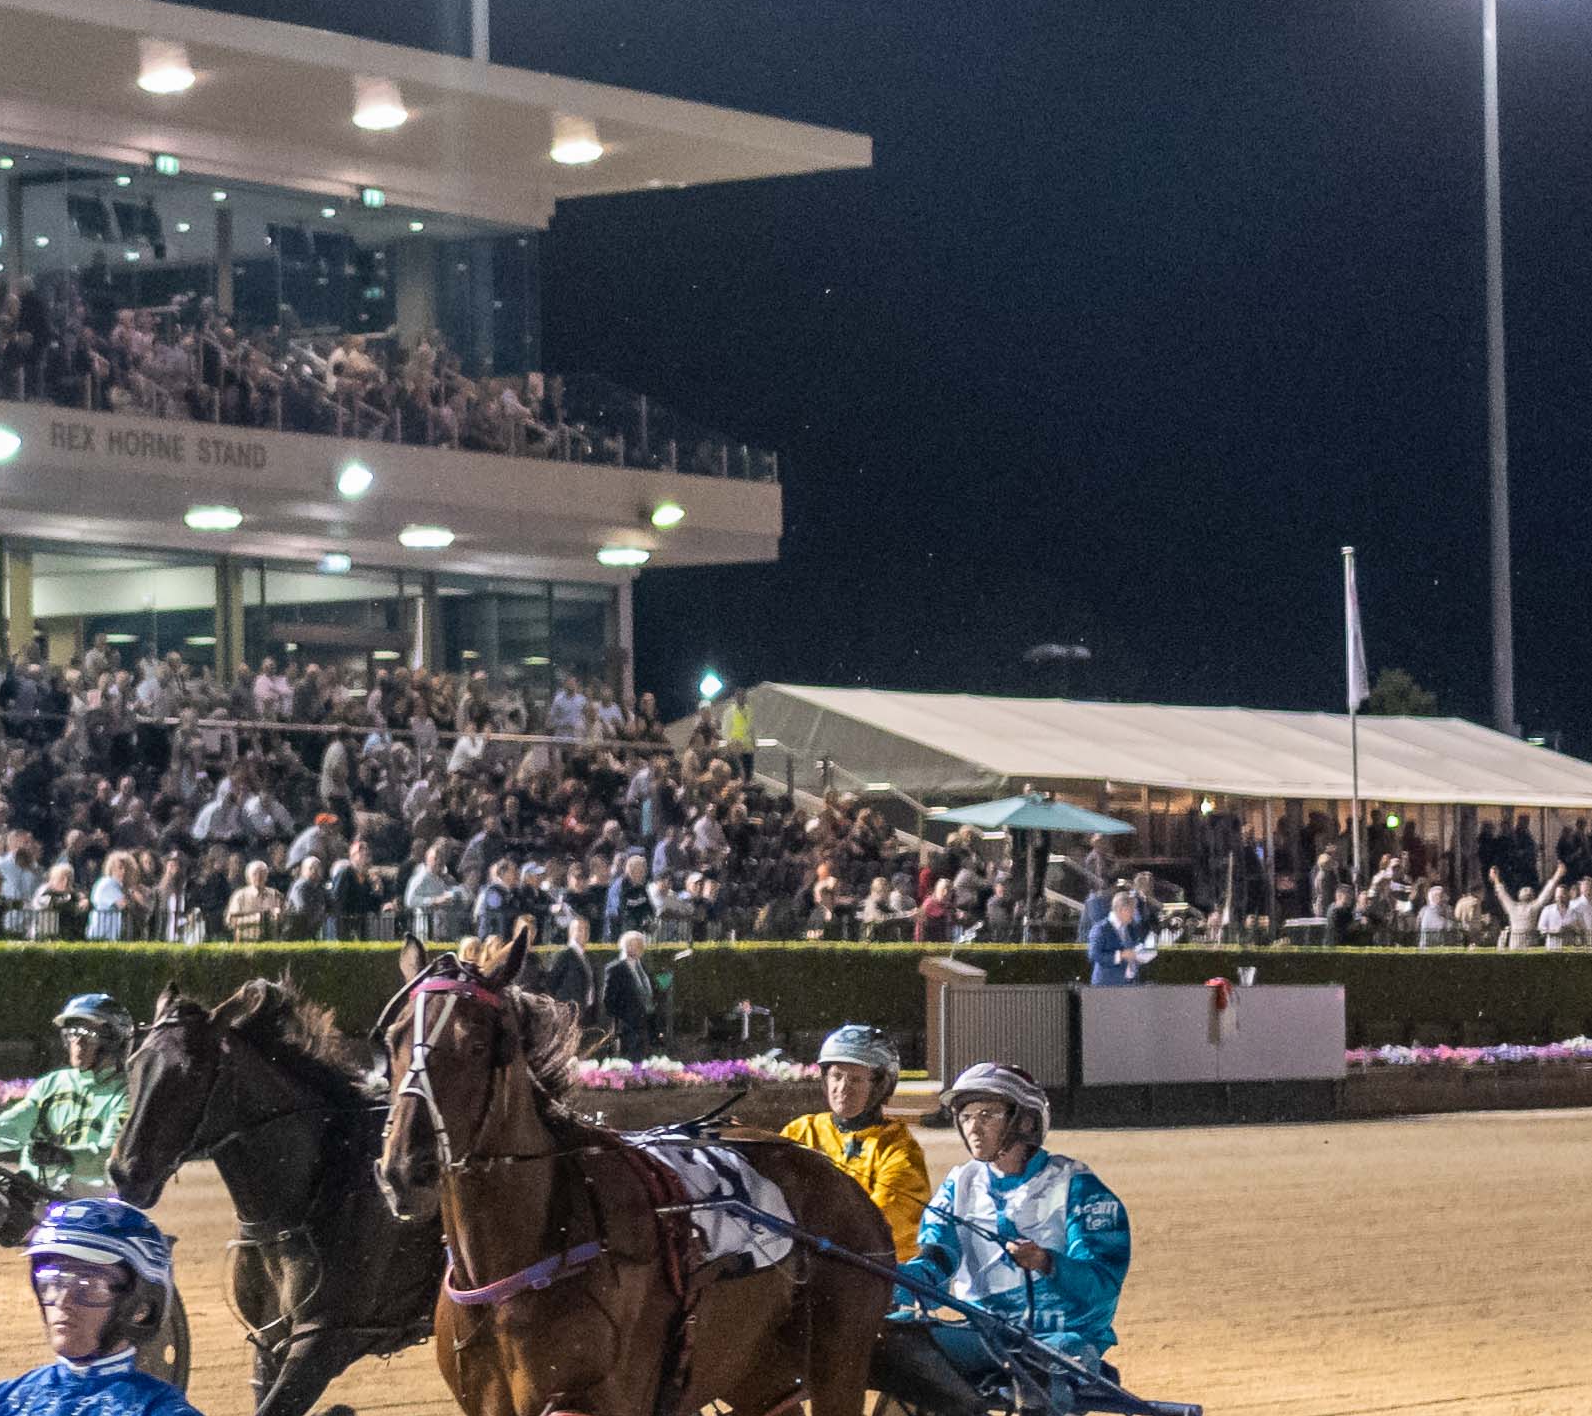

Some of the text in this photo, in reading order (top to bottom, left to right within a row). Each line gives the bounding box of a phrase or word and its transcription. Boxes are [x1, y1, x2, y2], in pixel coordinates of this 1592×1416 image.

[50, 420, 267, 470] REX HORNE STAND
